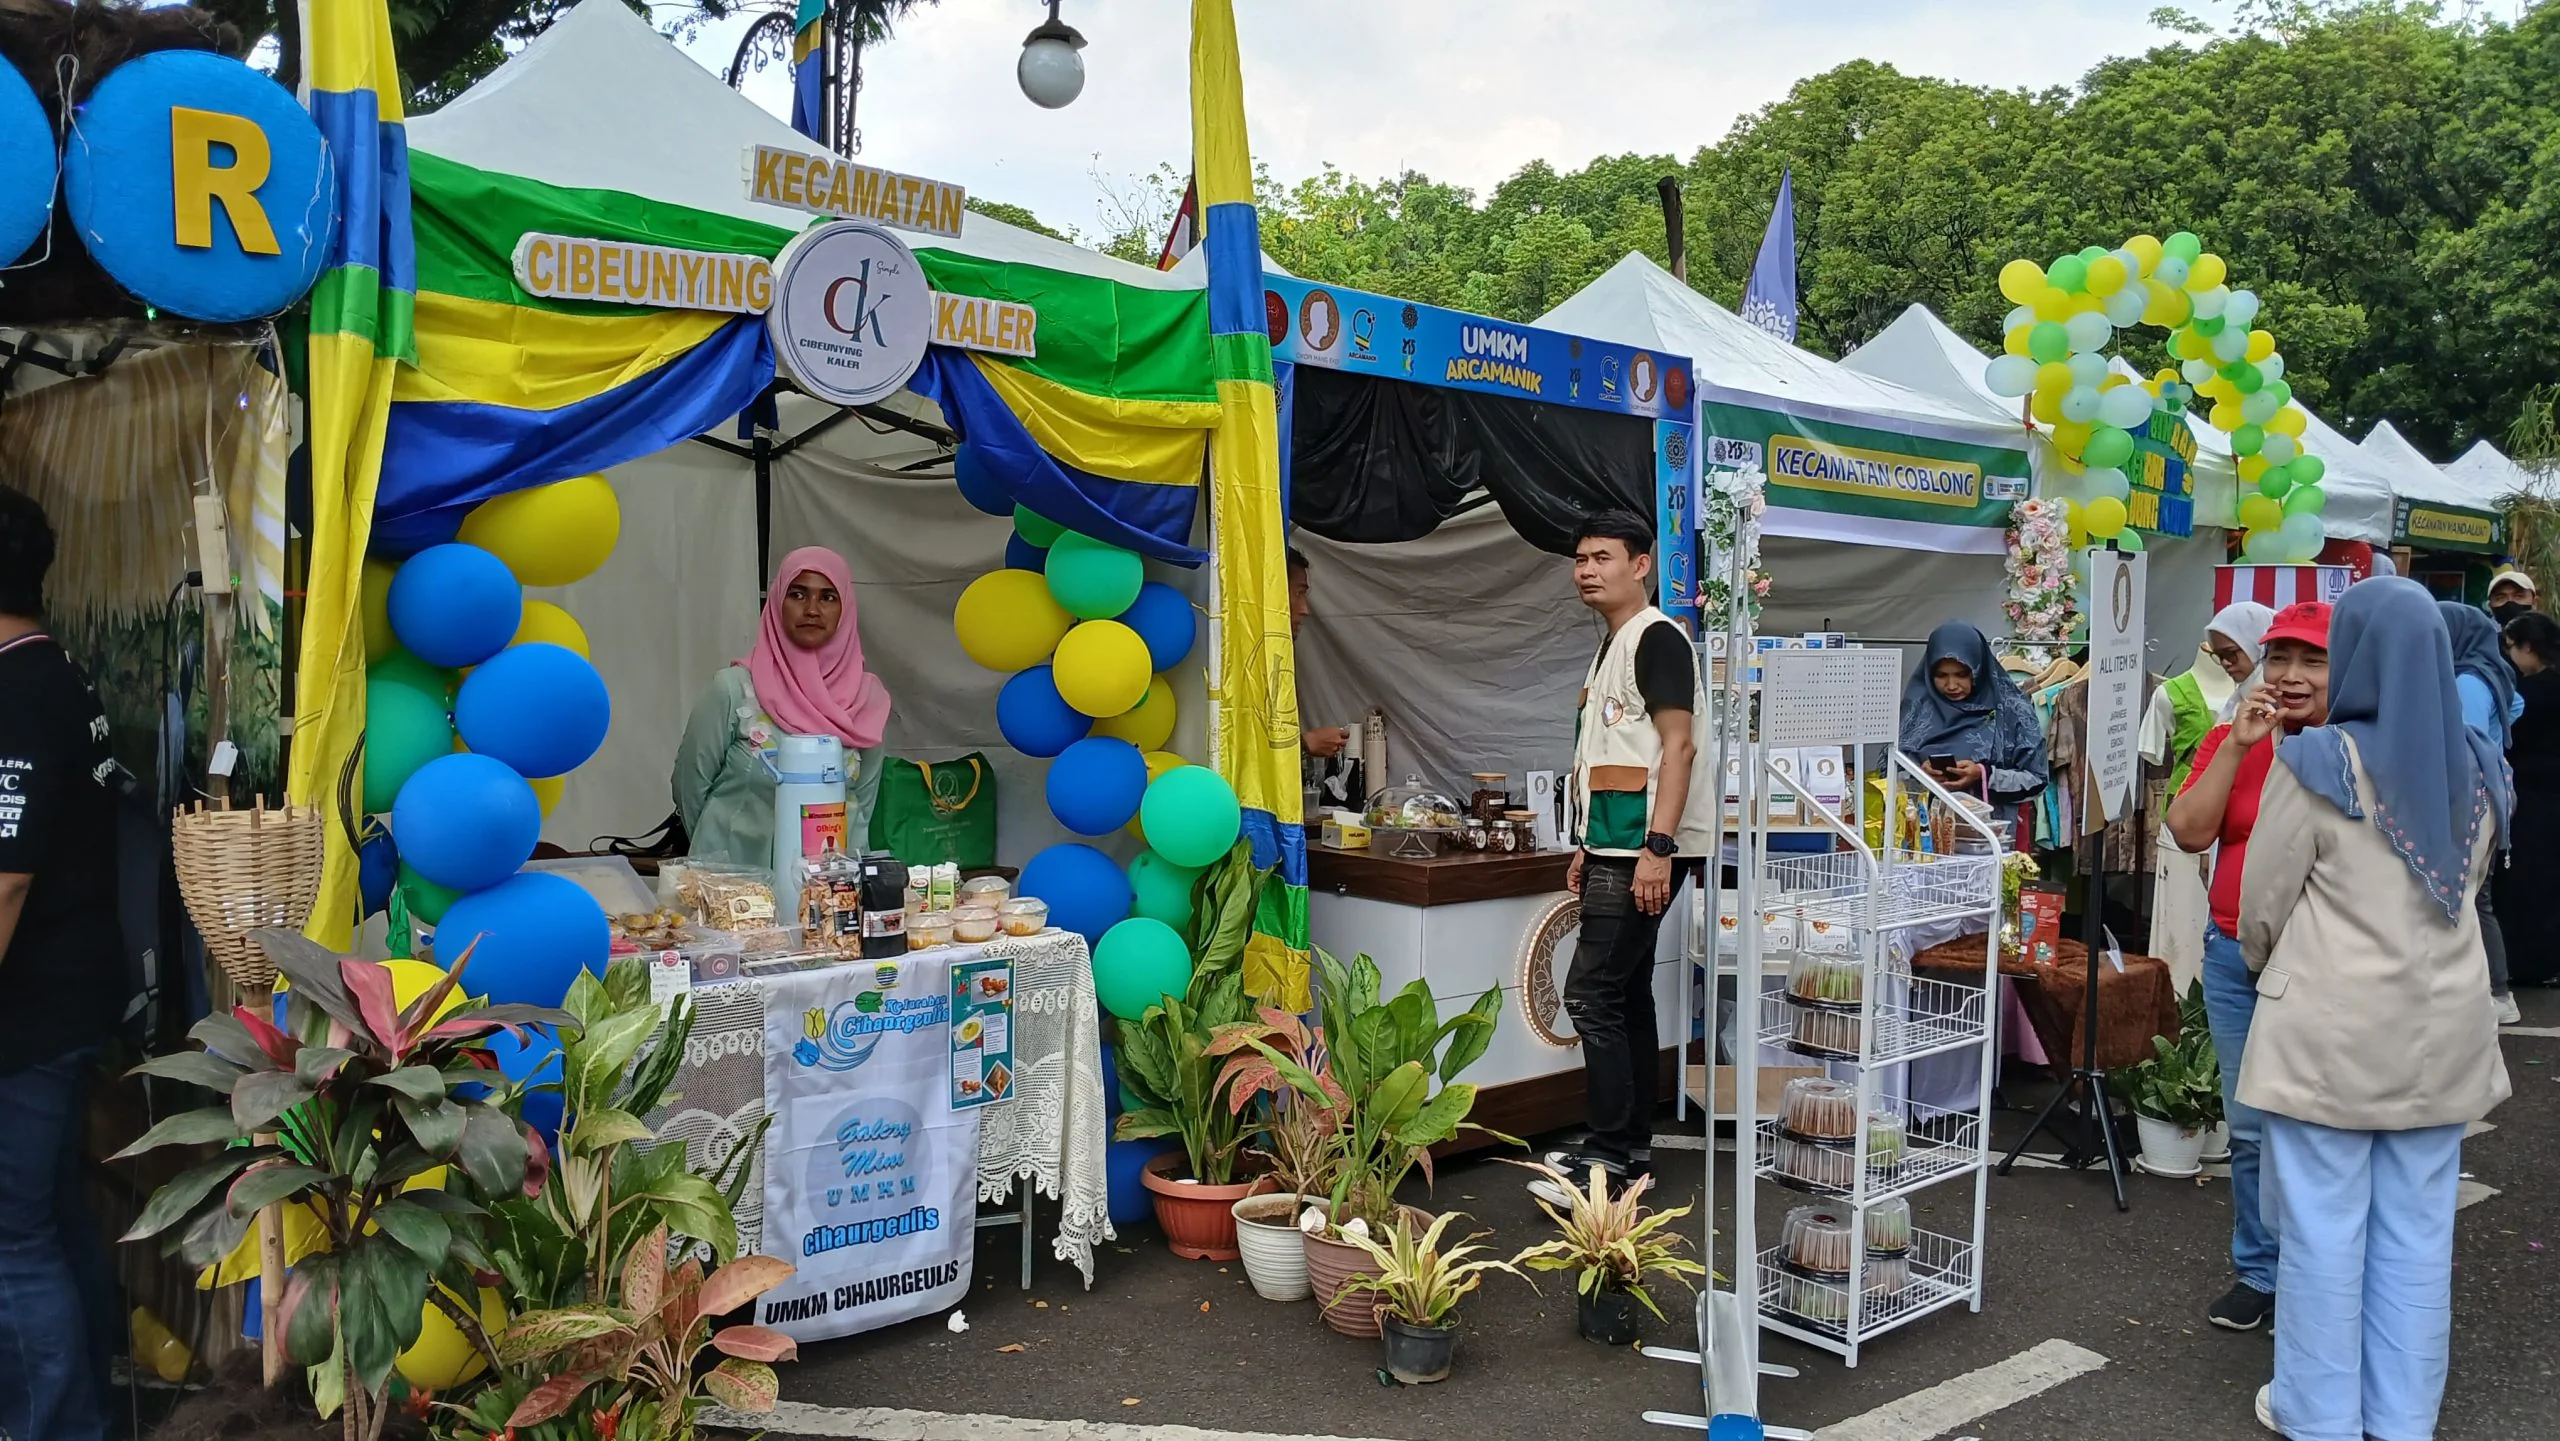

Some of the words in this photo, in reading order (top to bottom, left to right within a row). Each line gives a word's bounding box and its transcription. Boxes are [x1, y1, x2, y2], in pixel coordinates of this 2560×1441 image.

[171, 105, 282, 256] R
[755, 149, 963, 239] KECAMATAN
[528, 239, 771, 311] CIBEUNYING
[936, 296, 1035, 353] KALER
[799, 337, 863, 358] CIBEUNYING
[826, 355, 860, 370] KALER
[1462, 325, 1528, 364] UMKM
[1446, 358, 1542, 395] ARCAMANIK
[1775, 446, 1892, 488] KECAMATAN
[1893, 465, 1974, 497] COBLONG
[2099, 657, 2113, 674] ALL
[2113, 655, 2128, 672] ITEM
[837, 1117, 911, 1151] Galery
[803, 1206, 939, 1257] cihaurgeulis
[765, 1292, 828, 1325] UMKM
[834, 1260, 958, 1312] CIHAURGEULIS
